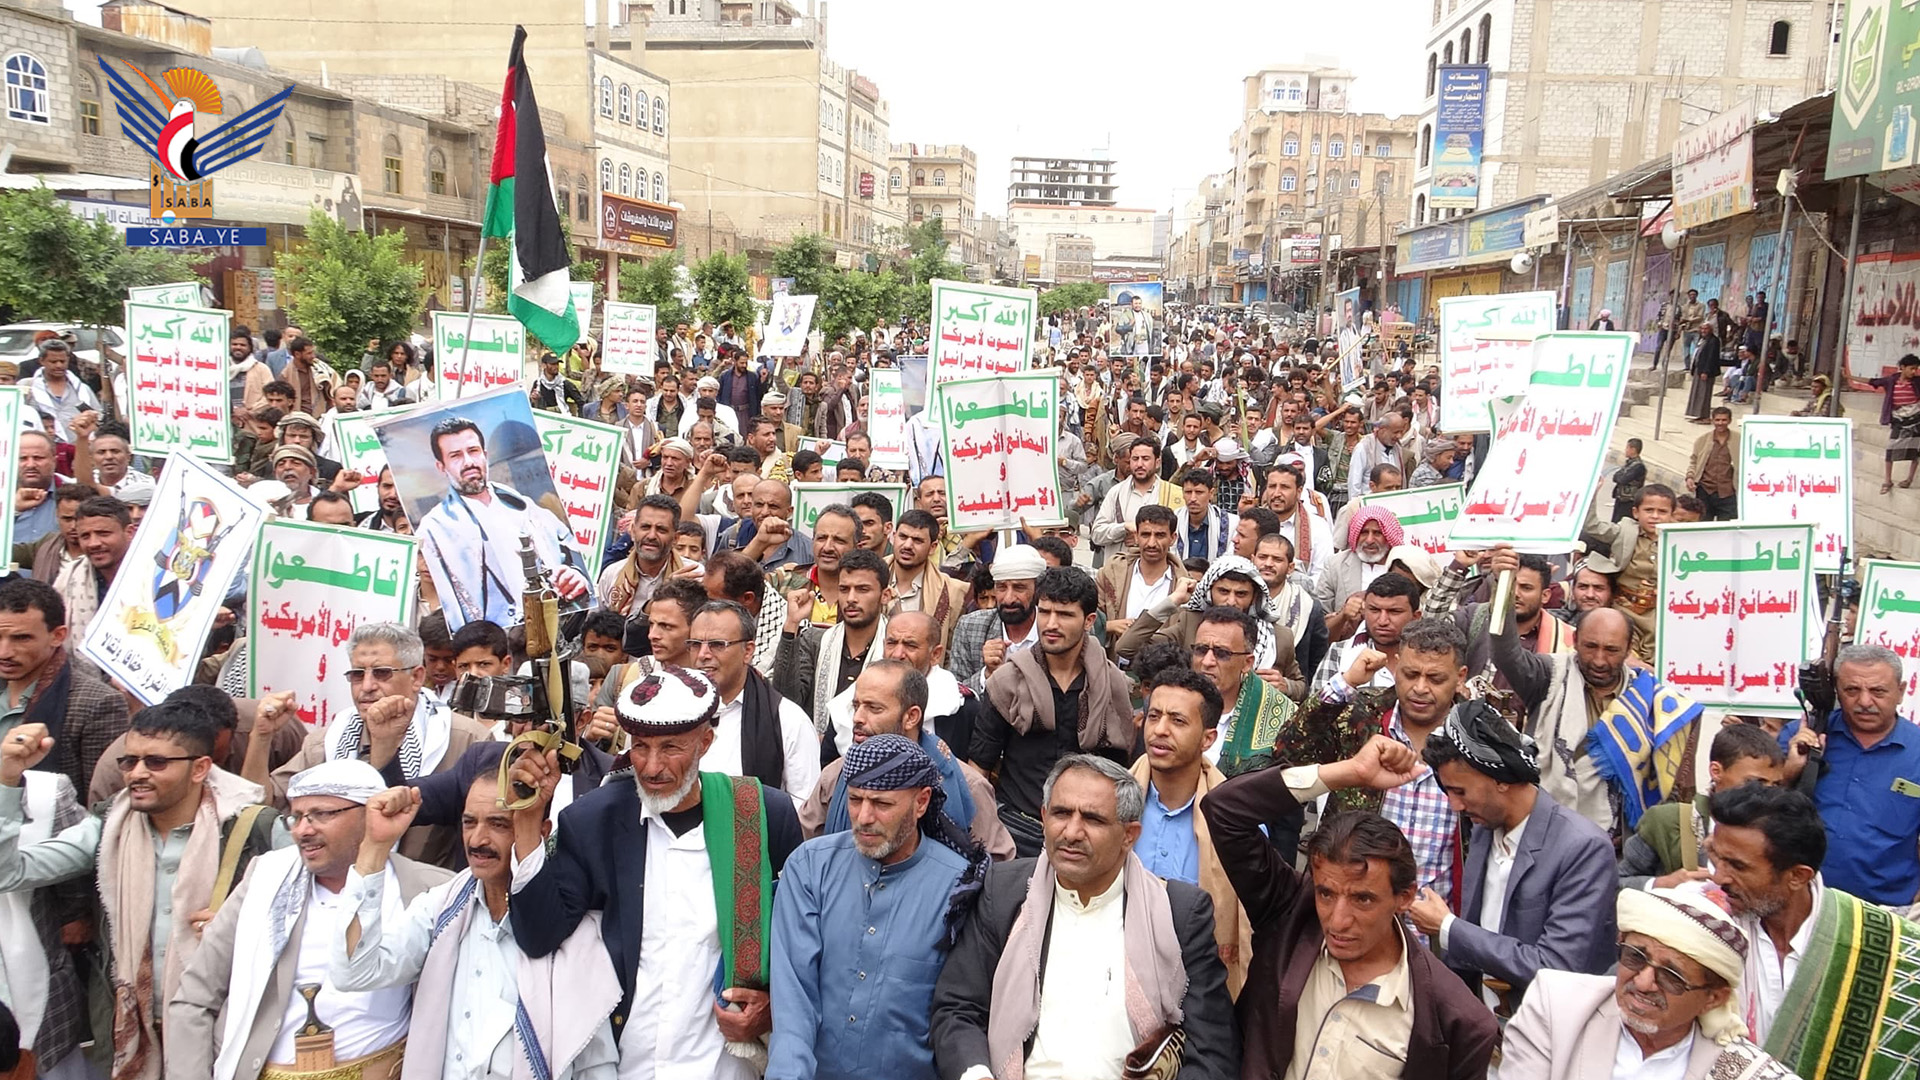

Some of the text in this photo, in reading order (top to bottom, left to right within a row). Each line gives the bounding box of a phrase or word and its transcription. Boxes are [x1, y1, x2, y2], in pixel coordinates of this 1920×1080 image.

[942, 297, 1026, 326] الله أكبر
[136, 313, 222, 344] الله أكبر
[942, 326, 1023, 352] الموت لأمريكا
[136, 346, 222, 371] الموت لأمريكا
[985, 360, 1021, 375] الموت
[184, 380, 222, 397] الموت
[137, 400, 222, 421] اللعنة على اليهود
[947, 391, 1048, 429] قاطعوا
[139, 422, 224, 449] النصر للإسلام
[1536, 409, 1602, 442] البضائع
[571, 434, 613, 463] الله
[952, 428, 1048, 462] البضائع الأمريكية
[1749, 434, 1841, 464] قاطعوا
[1000, 462, 1006, 481] و
[1515, 449, 1526, 475] و
[560, 471, 606, 492] الموت
[1747, 469, 1841, 498] البضائع الأمريكية
[958, 487, 1055, 515] الإسرائيلية
[263, 540, 399, 597] قاطعوا
[1671, 541, 1801, 580] قاطعوا
[1668, 586, 1797, 620] البضائع الأمريكية
[261, 601, 331, 640] الأمريكية
[1724, 627, 1734, 651] و
[317, 654, 327, 682] و
[1667, 661, 1796, 693] الإسرائيلية
